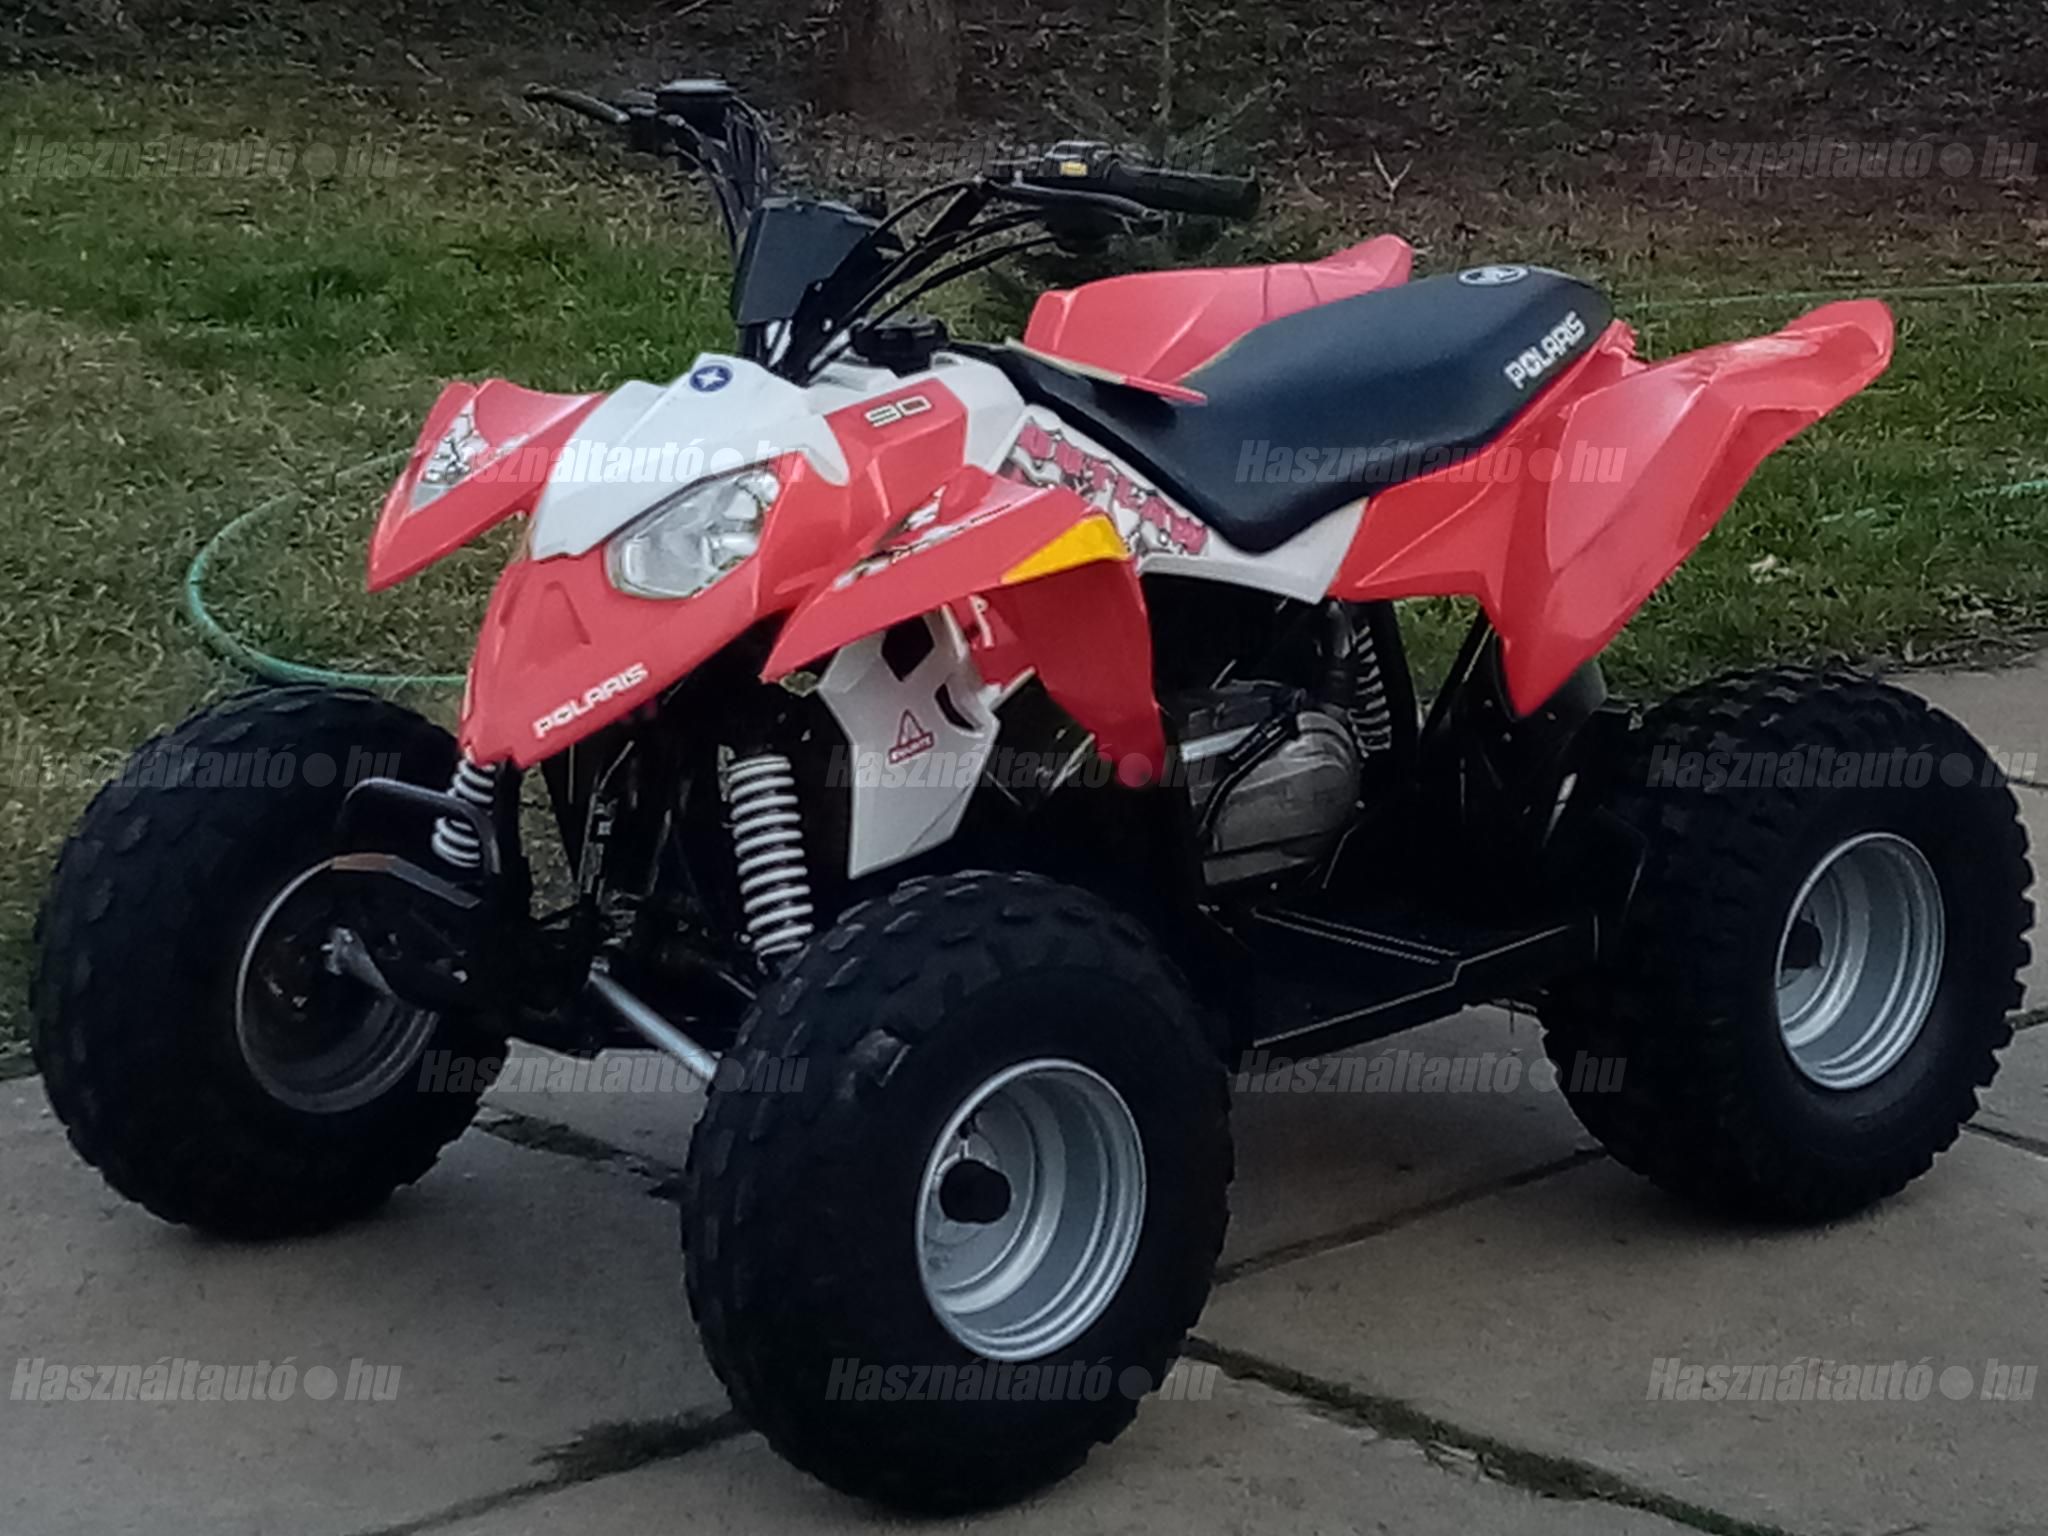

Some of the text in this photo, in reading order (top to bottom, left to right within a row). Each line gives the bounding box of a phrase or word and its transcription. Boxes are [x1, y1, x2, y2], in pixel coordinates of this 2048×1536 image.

[1504, 311, 1586, 389] POLARIS
[864, 395, 932, 428] 90
[533, 661, 648, 738] POLARIS
